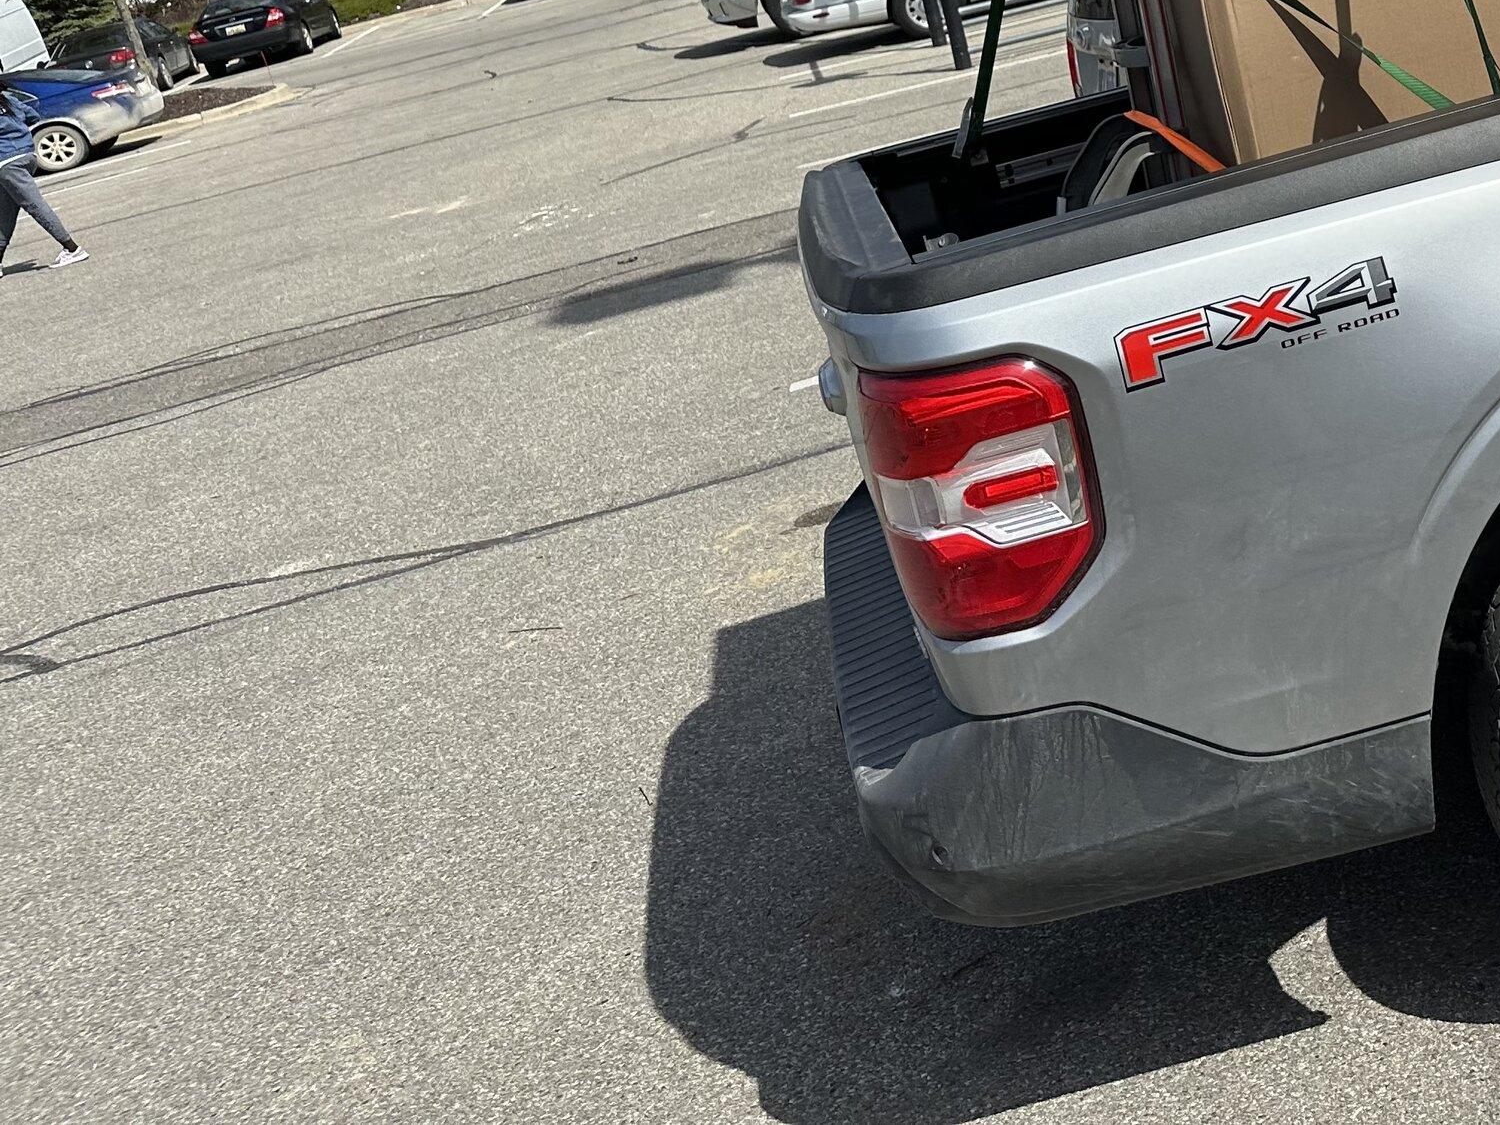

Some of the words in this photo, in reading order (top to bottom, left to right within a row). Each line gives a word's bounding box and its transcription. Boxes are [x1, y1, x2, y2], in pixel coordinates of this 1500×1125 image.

[1113, 255, 1398, 393] FX4
[1280, 328, 1327, 350] OFF
[1338, 308, 1400, 333] ROAD
